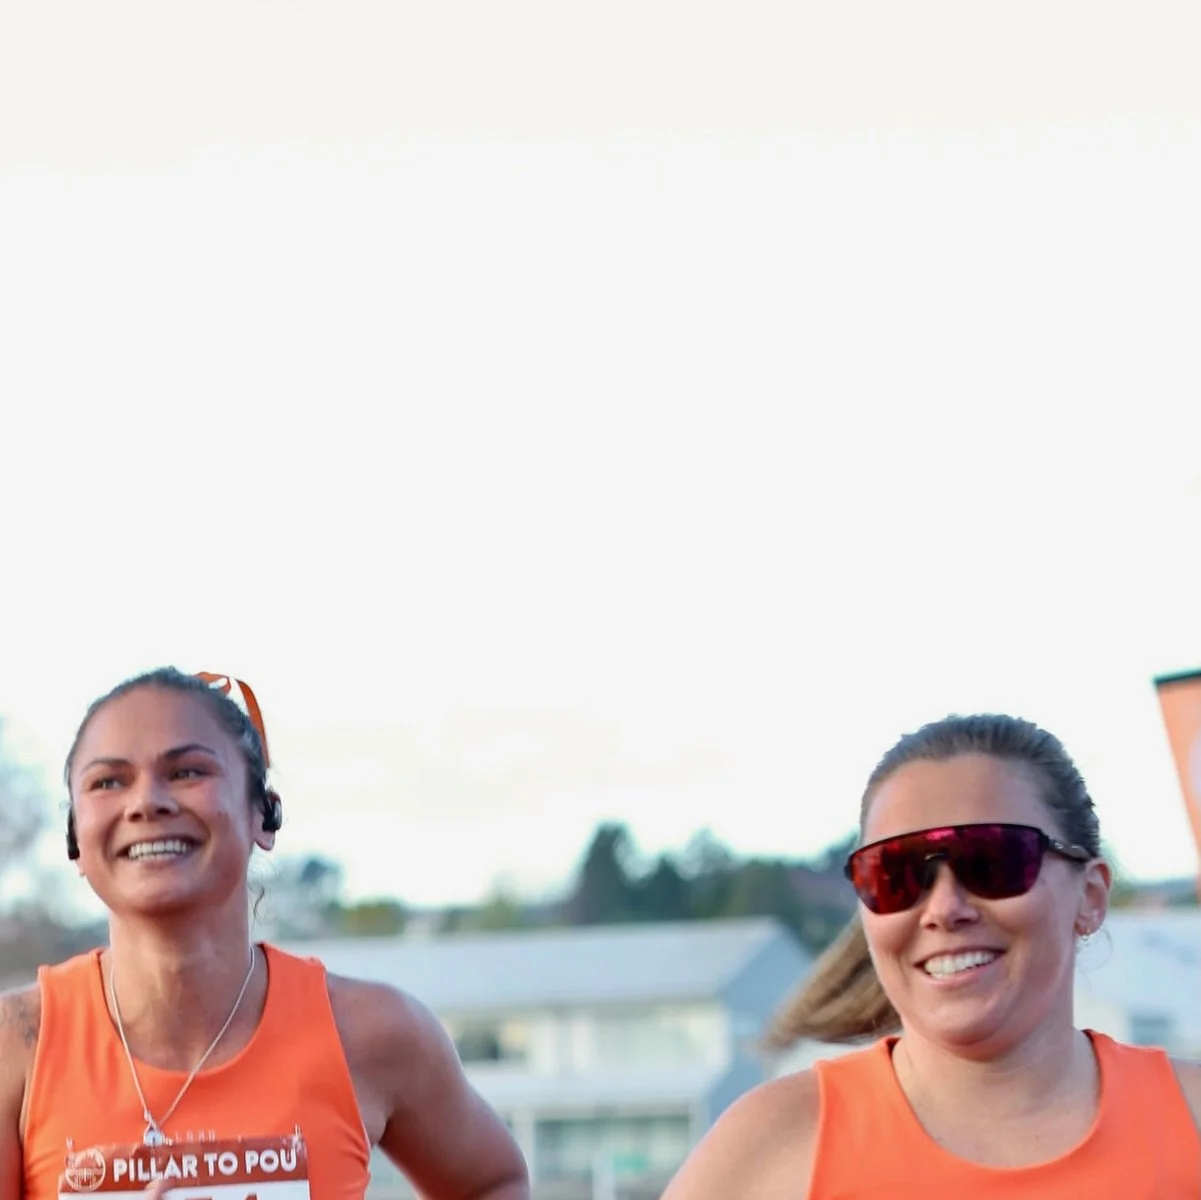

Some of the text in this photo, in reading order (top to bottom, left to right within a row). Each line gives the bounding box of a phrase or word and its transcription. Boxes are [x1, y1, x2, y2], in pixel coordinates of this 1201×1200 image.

[113, 1154, 198, 1183] PILLAR
[203, 1152, 239, 1177] TO
[245, 1148, 298, 1174] POU
